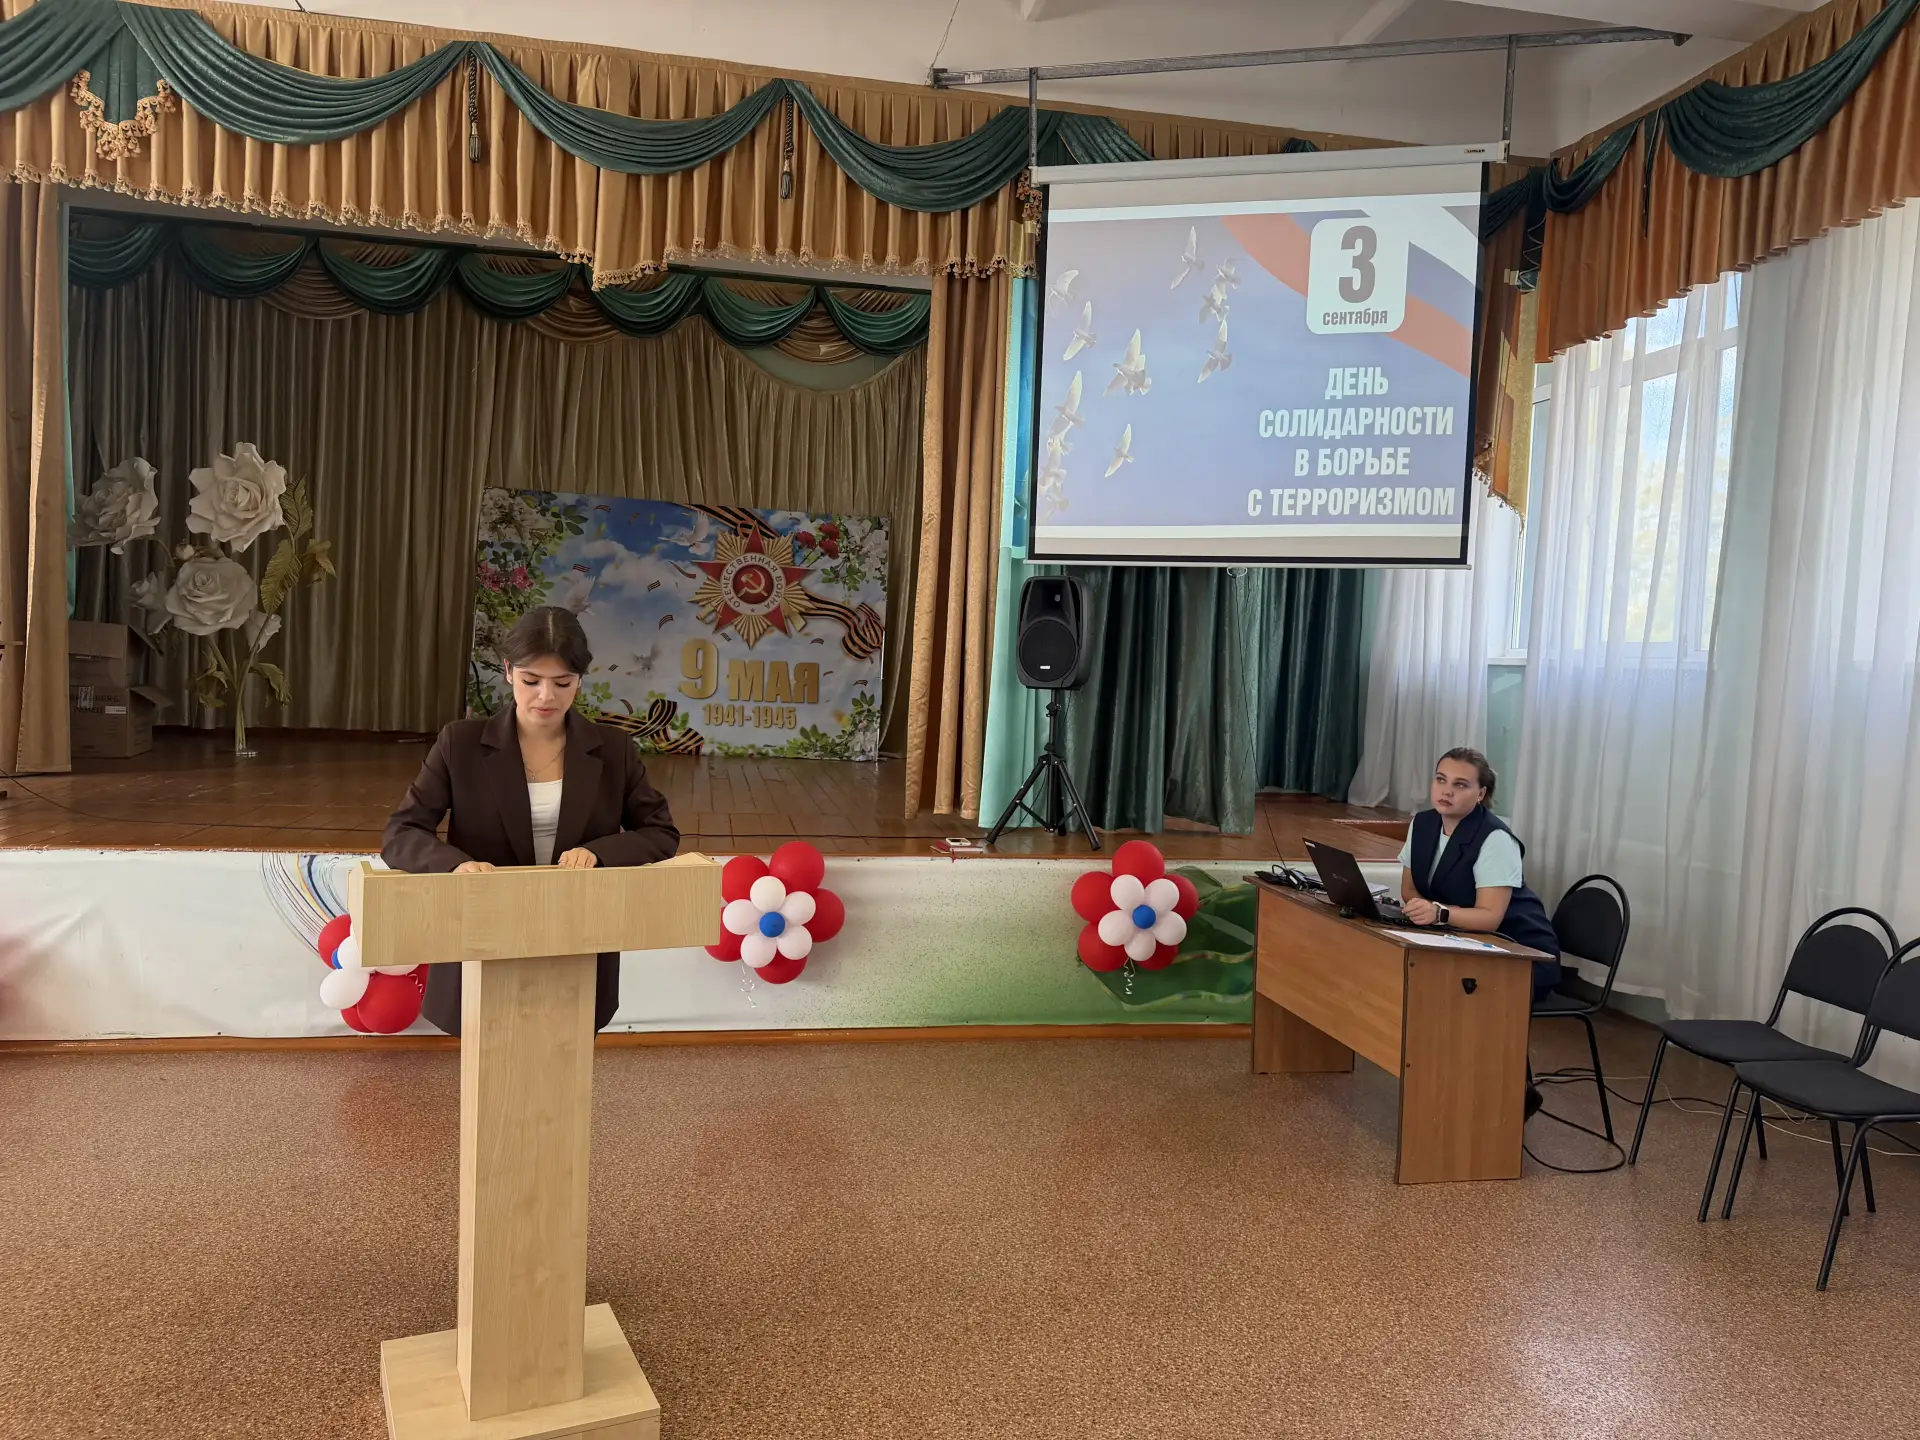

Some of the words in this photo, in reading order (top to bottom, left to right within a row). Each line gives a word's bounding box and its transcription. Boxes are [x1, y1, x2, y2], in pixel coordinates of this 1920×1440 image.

[1338, 225, 1378, 304] 3
[1322, 308, 1388, 326] сентября
[1324, 367, 1389, 400] ДЕНЬ
[1259, 406, 1454, 440] СОЛИДАРНОСТИ
[1294, 448, 1310, 477] В
[1317, 446, 1411, 476] БОРЬБЕ
[1247, 488, 1263, 516] С
[1270, 486, 1456, 516] ТЕРРОРИЗМОМ
[723, 555, 778, 608] ОТЕЧЕСТВЕННАЯ
[764, 575, 783, 609] ВОЙНА
[679, 638, 719, 699] 9
[728, 659, 820, 704] МАЯ
[702, 703, 797, 729] 1941-1945
